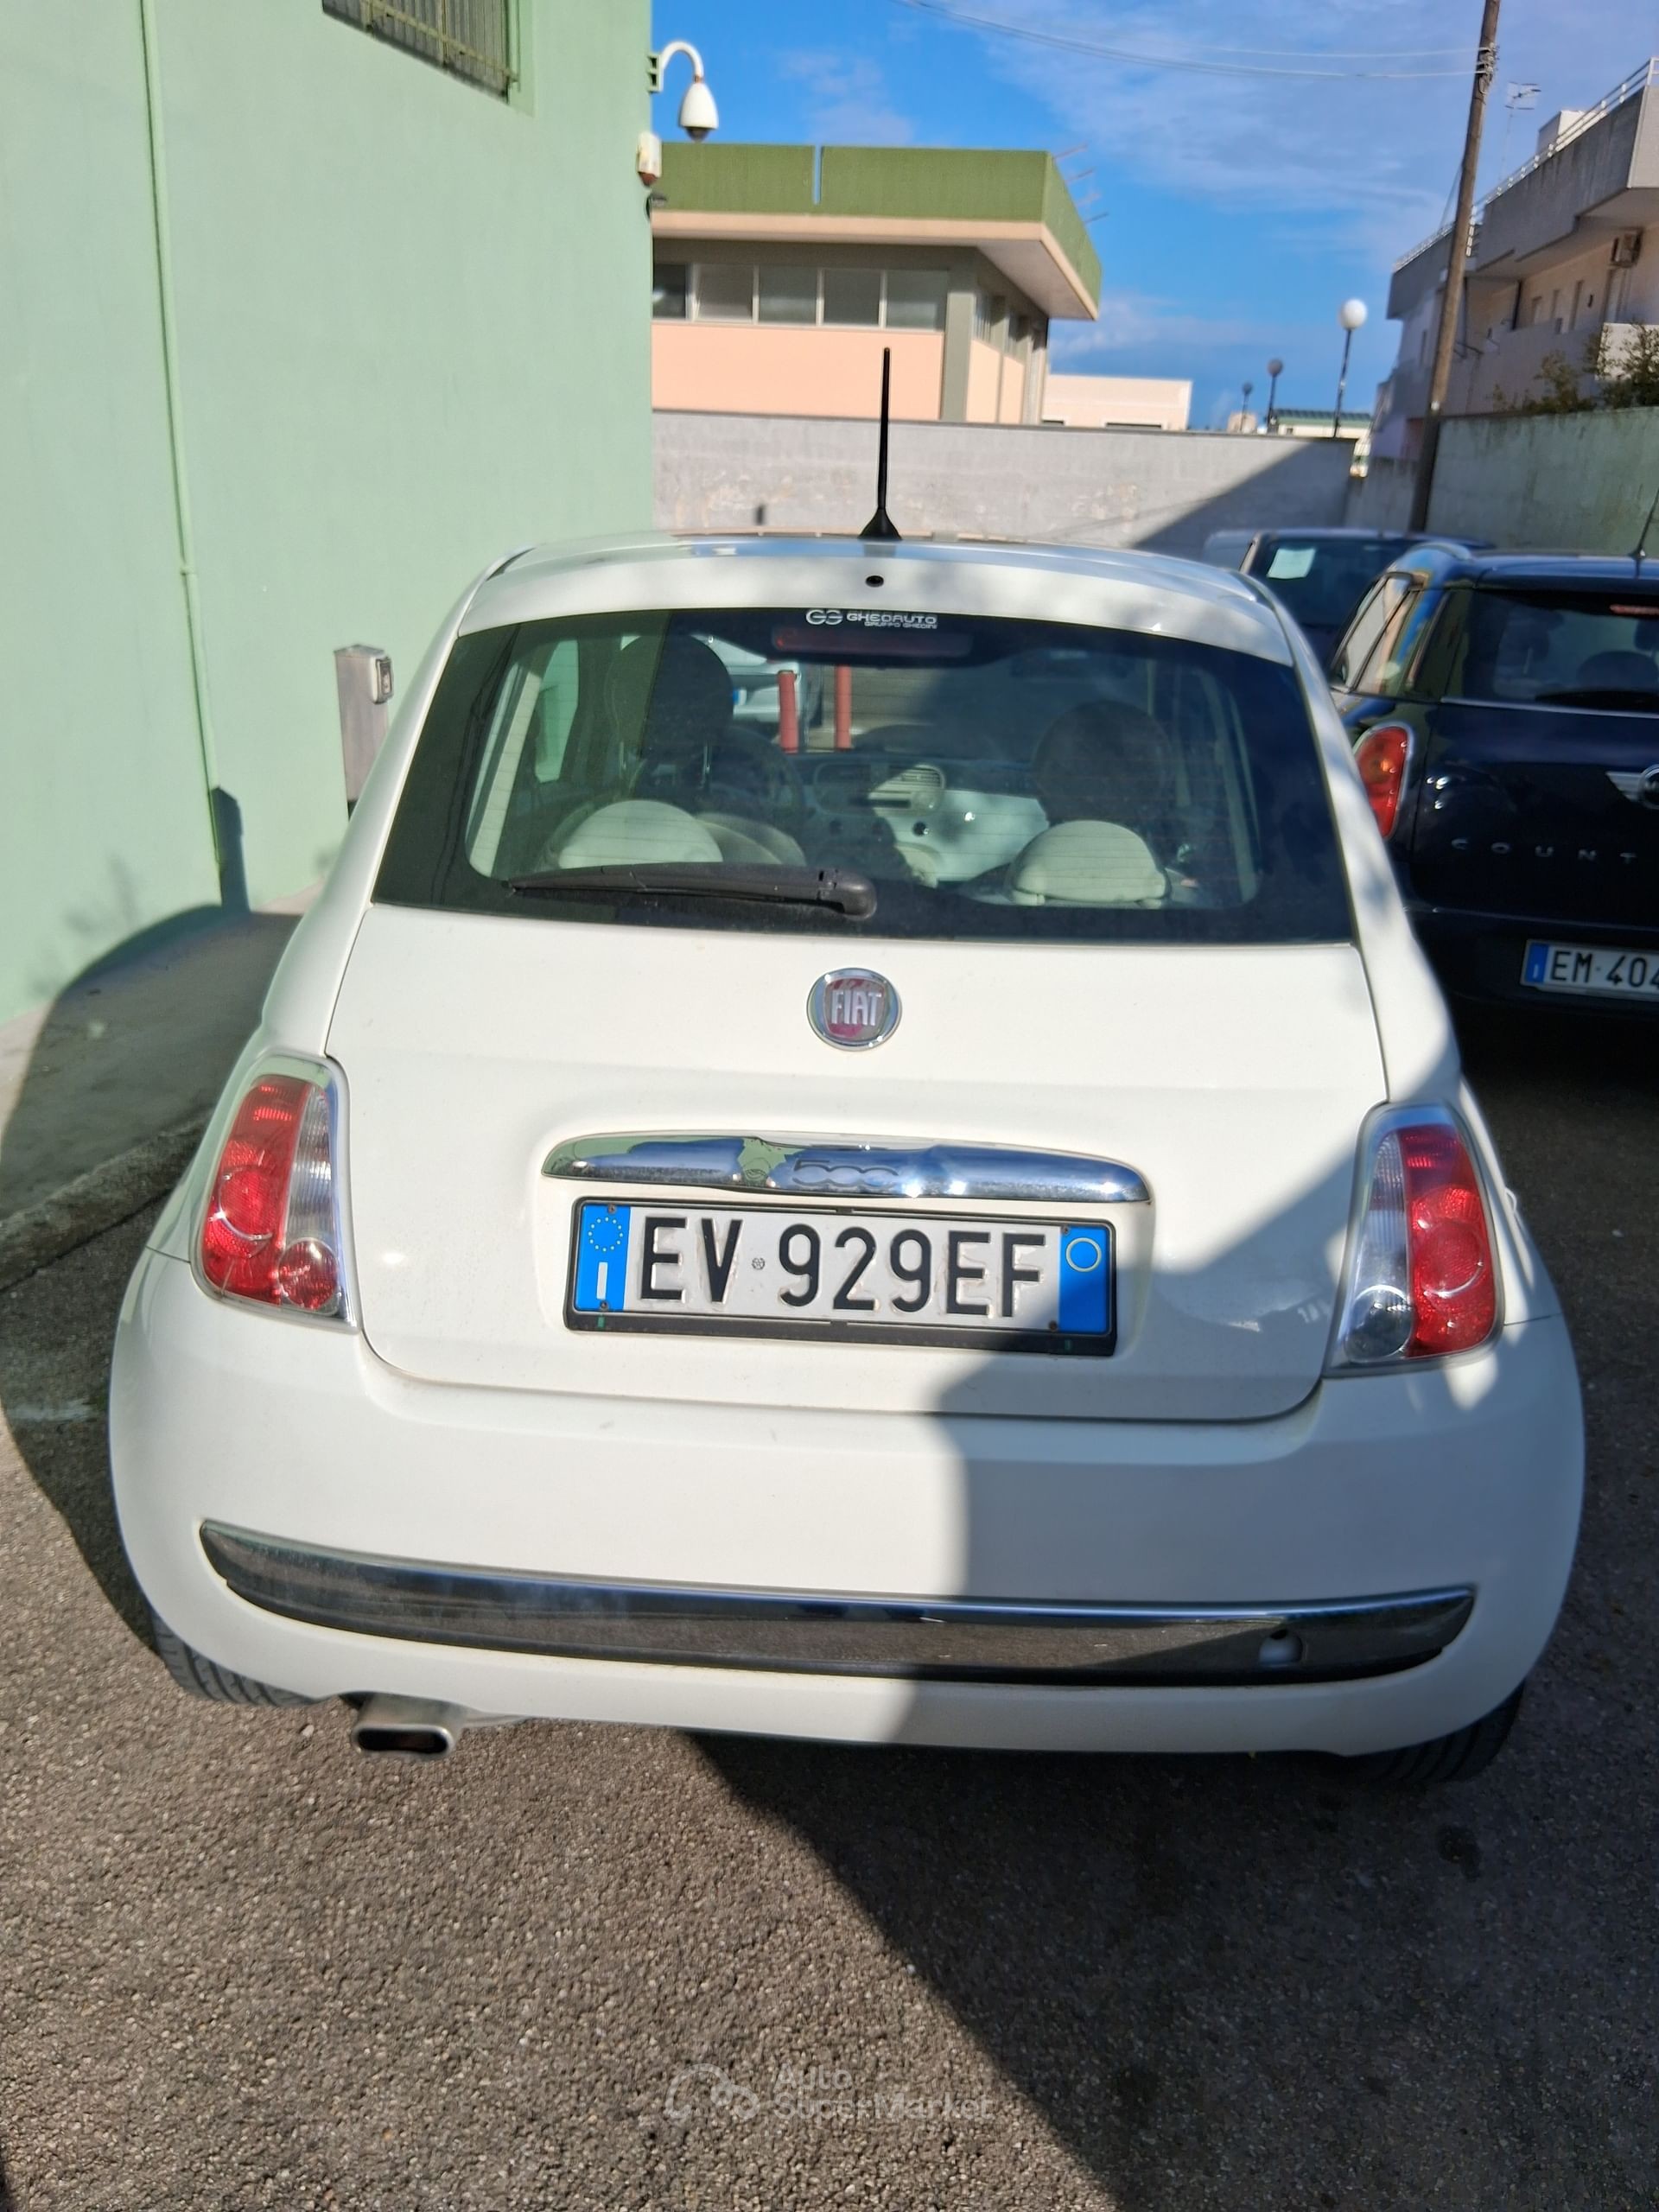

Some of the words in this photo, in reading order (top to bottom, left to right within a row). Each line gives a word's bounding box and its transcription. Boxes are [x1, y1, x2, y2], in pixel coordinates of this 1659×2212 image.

[830, 989, 881, 1026] FIAT
[792, 1160, 899, 1187] 500
[640, 1217, 743, 1303] EV
